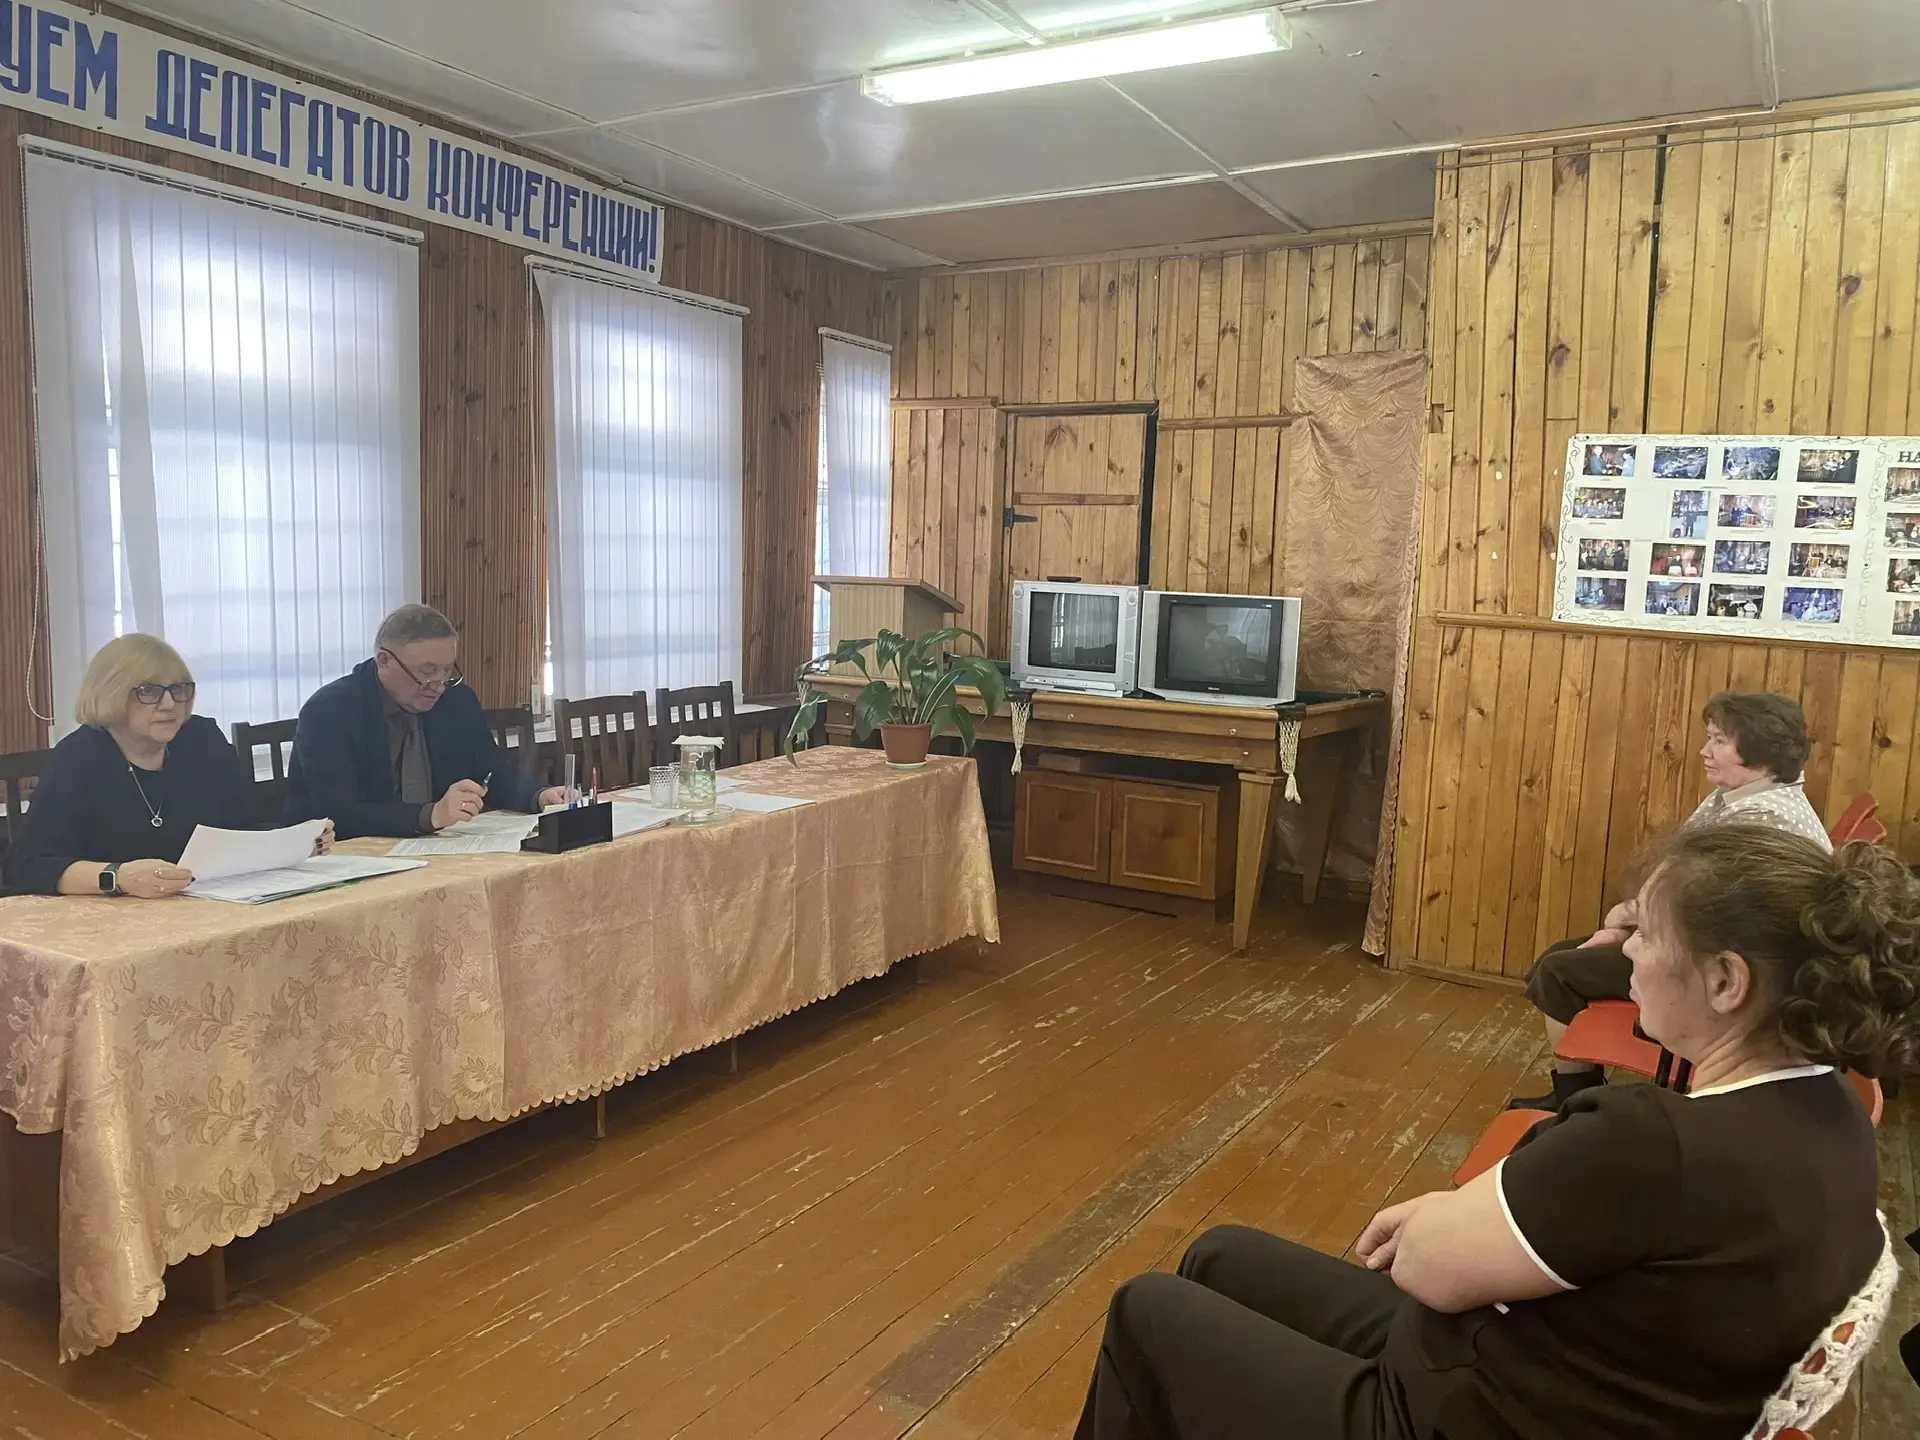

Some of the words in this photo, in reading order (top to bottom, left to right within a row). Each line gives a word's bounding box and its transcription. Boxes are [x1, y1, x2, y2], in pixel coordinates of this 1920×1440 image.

[0, 0, 117, 120] УЕМ
[145, 49, 411, 201] ДЕЛЕГАТОВ
[427, 137, 657, 273] КОНФЕРЕНЦИИ!
